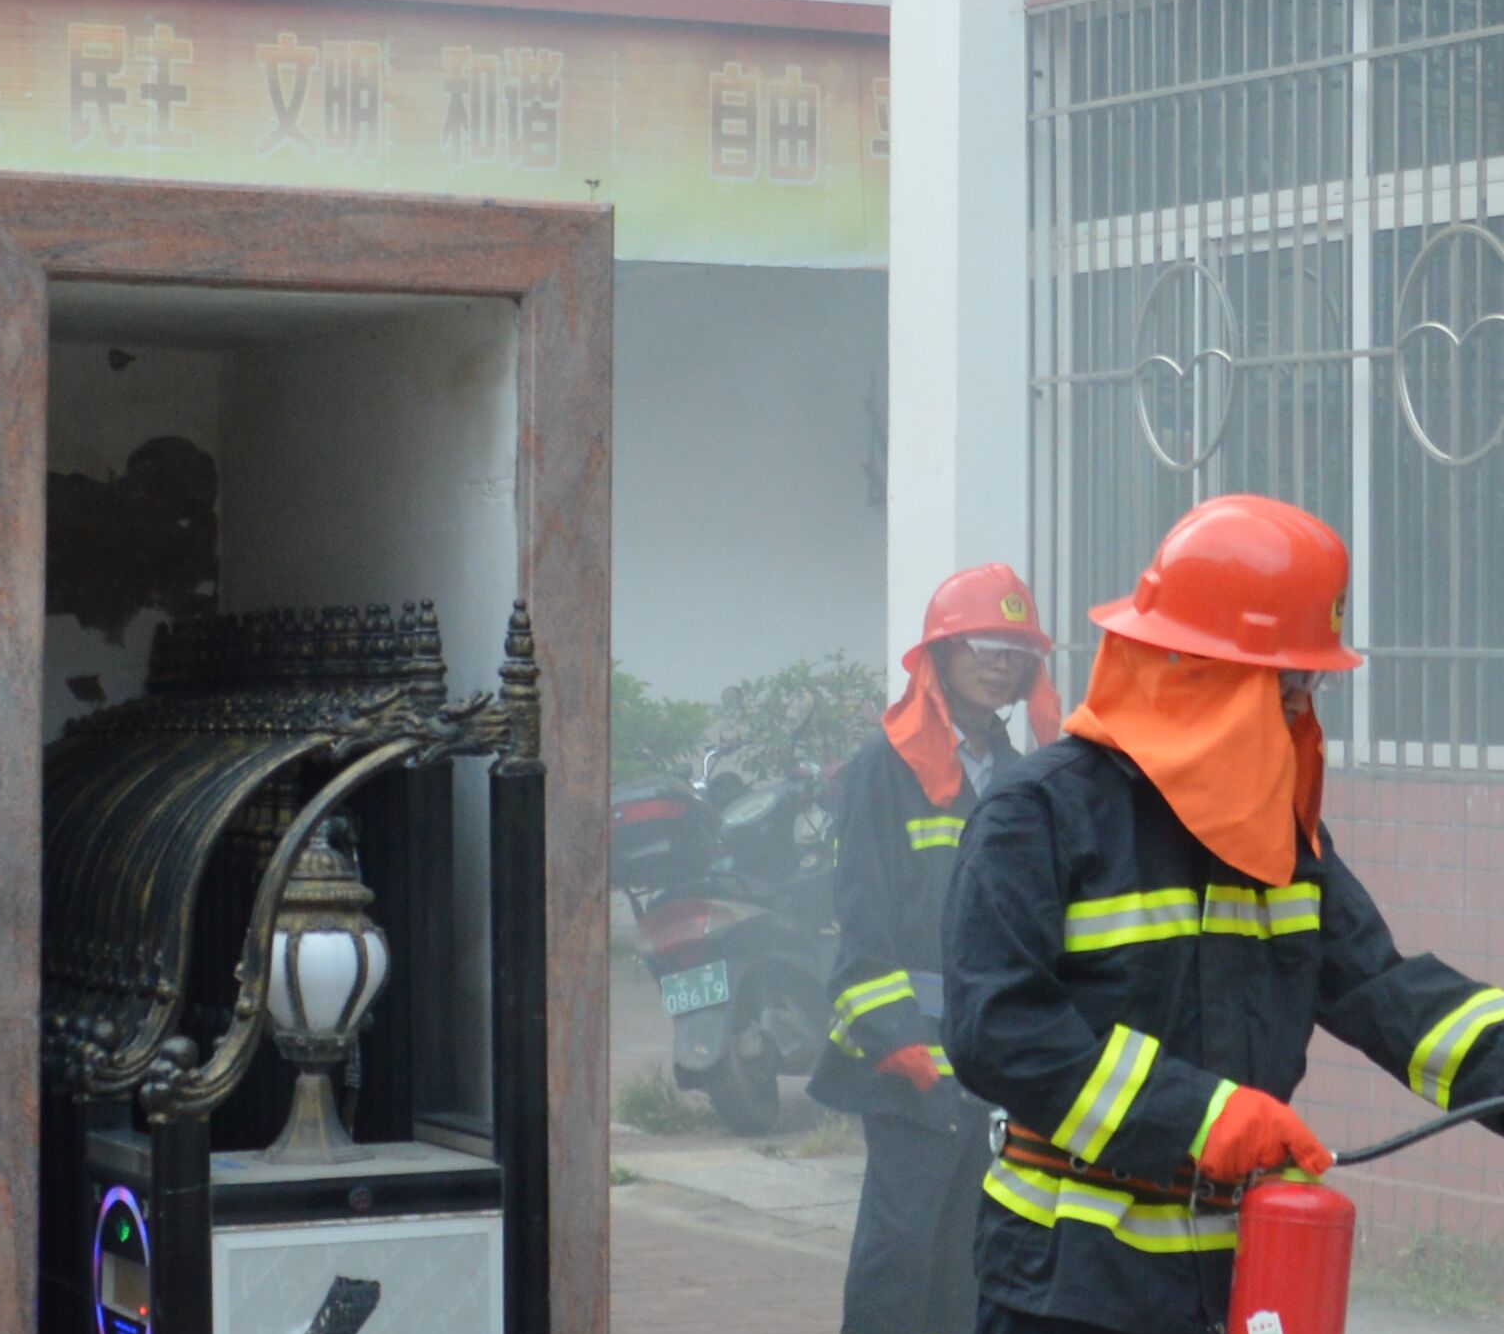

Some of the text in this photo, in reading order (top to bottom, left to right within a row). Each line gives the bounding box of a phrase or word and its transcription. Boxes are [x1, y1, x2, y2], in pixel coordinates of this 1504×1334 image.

[66, 17, 195, 155] 民主
[254, 29, 384, 164] 文明
[439, 43, 564, 175] 和谐
[707, 62, 823, 187] 自由
[666, 981, 724, 1013] 08619
